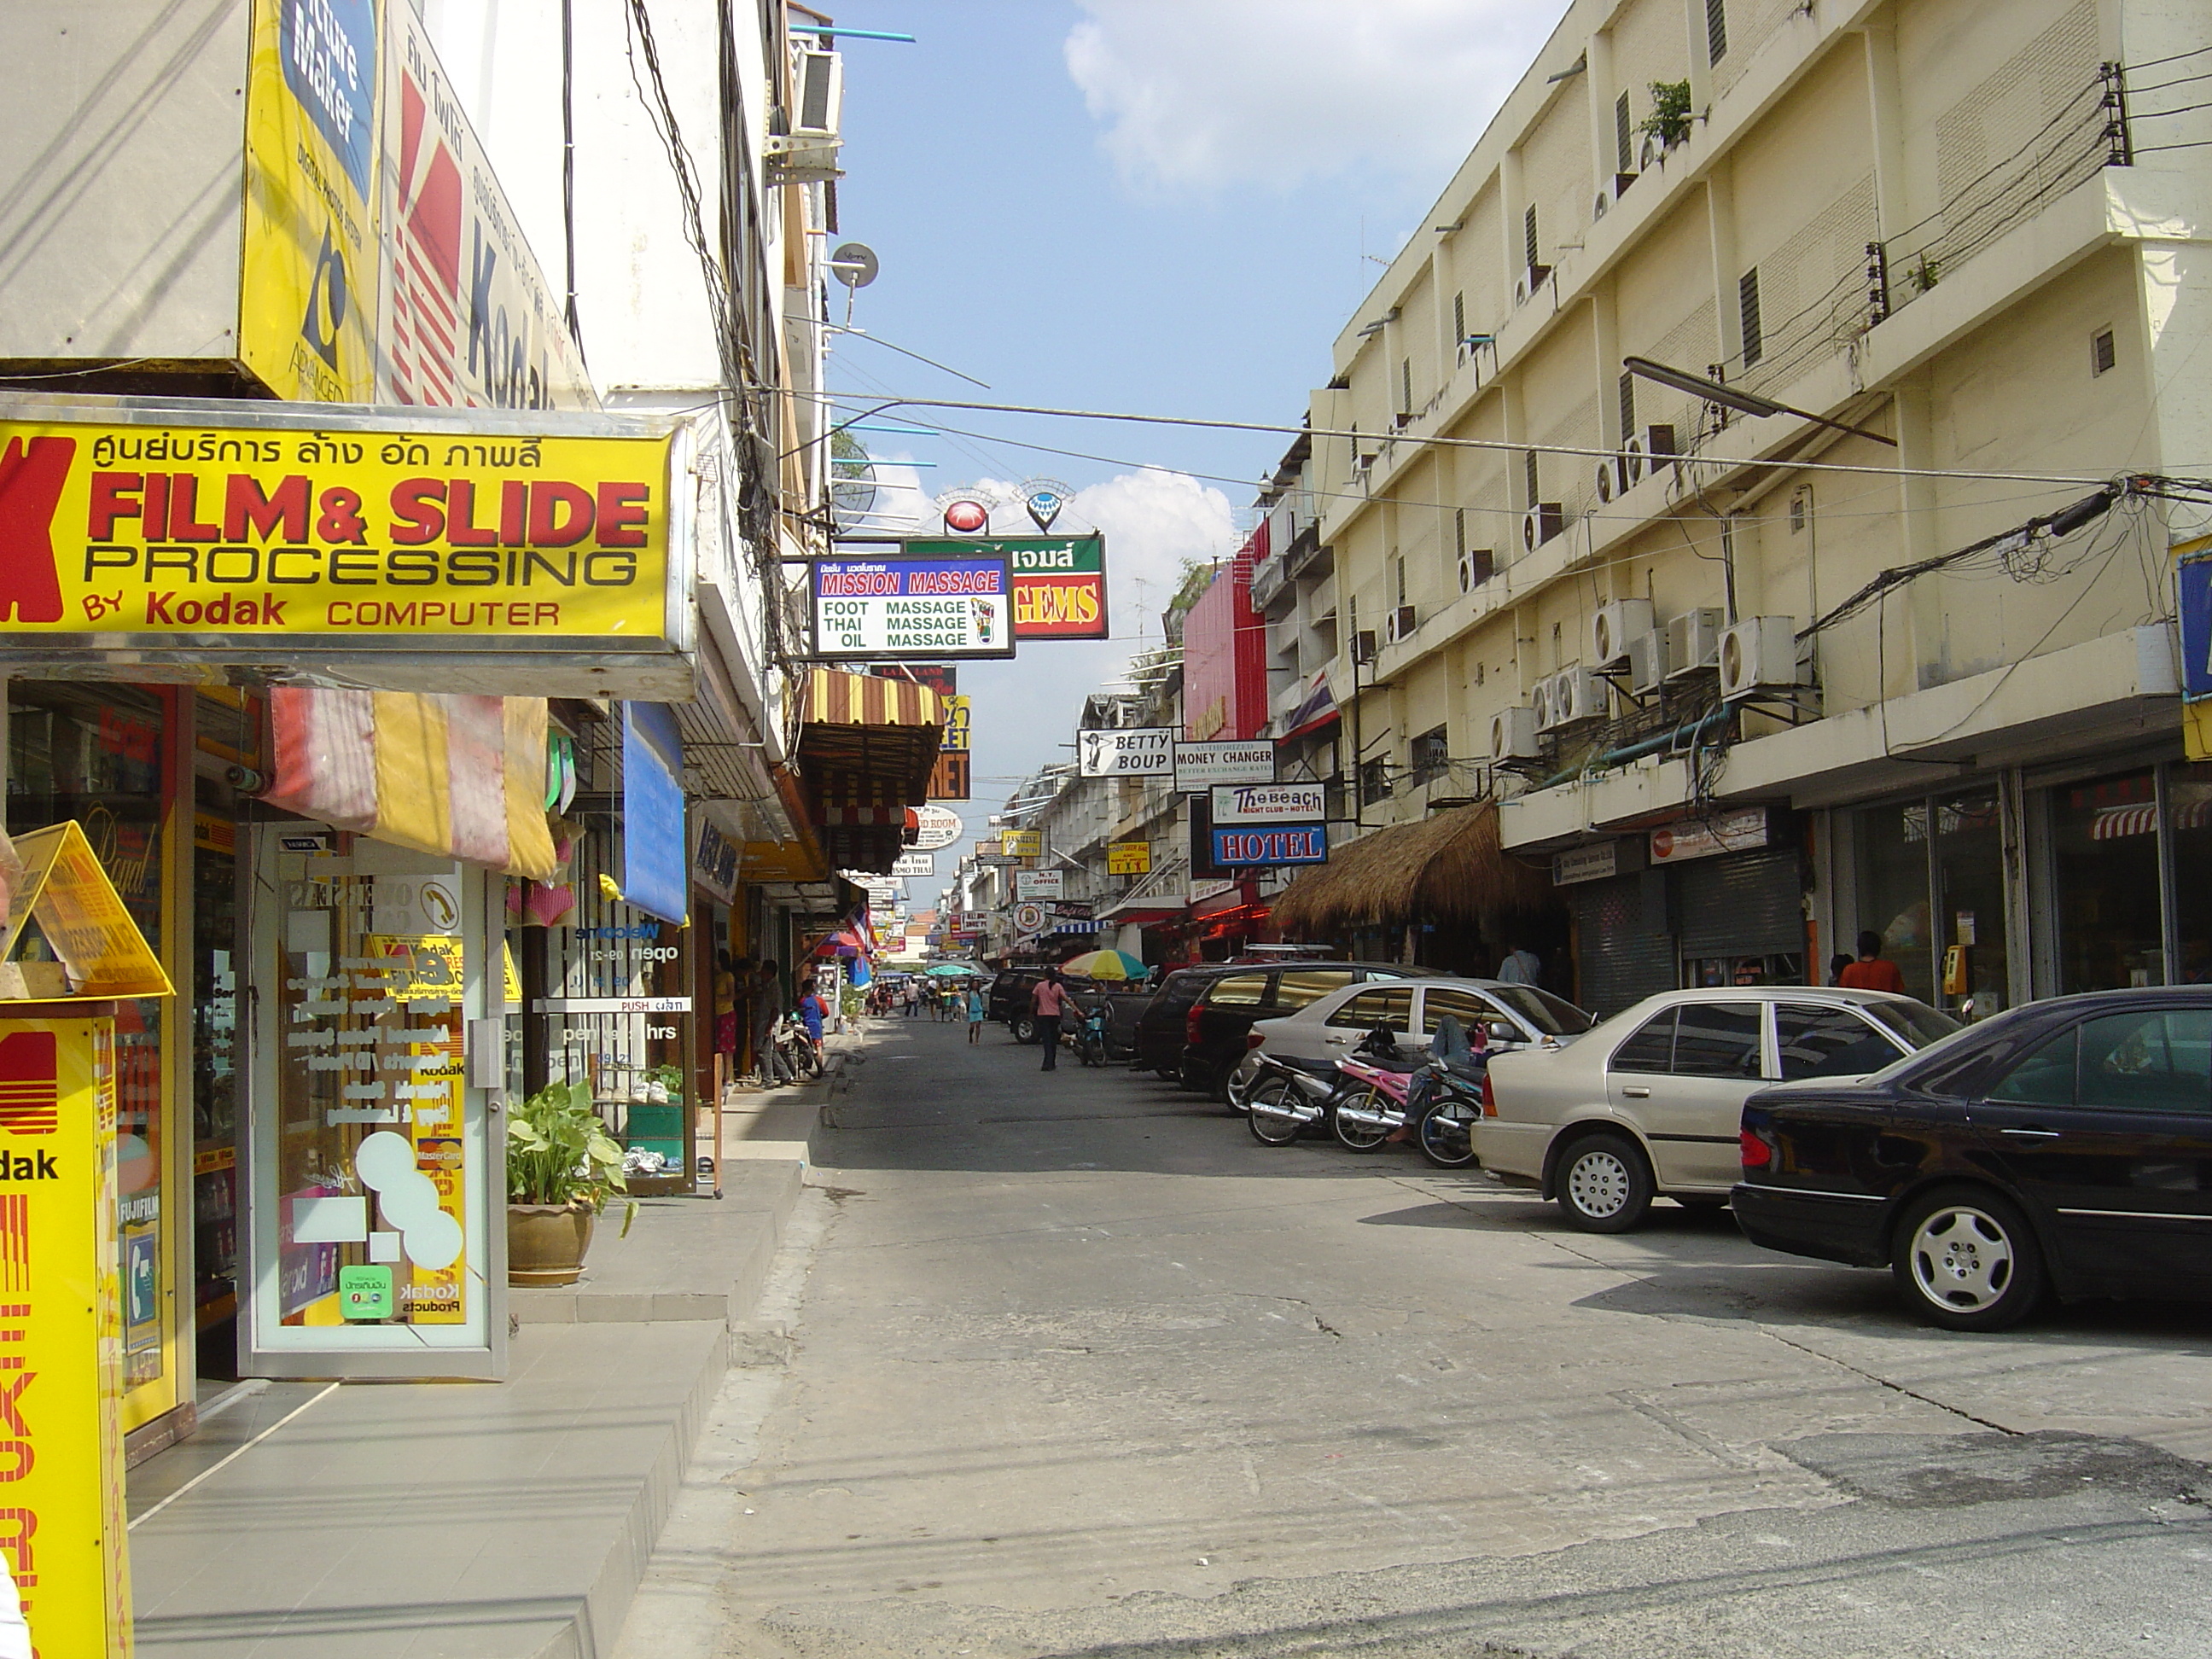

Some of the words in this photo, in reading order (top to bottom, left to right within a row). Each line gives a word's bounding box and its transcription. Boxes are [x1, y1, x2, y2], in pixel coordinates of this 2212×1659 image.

[293, 2, 353, 144] Maker
[297, 432, 364, 465] ล้าง
[381, 436, 429, 466] อัด
[444, 436, 542, 469] ภาพสี
[389, 477, 650, 548] SLIDE
[83, 544, 637, 587] PROCESSING
[820, 572, 900, 596] MISSION
[908, 569, 1000, 595] MASSAGE
[81, 589, 124, 622] BY
[145, 590, 288, 626] Kodak
[326, 600, 561, 627] COMPUTER
[824, 601, 870, 616] FOOT
[886, 600, 966, 614] MASSAGE
[1014, 582, 1099, 625] GEMS
[824, 617, 862, 632] THAI
[887, 616, 967, 631] MASSAGE
[841, 633, 867, 648] OIL
[887, 632, 968, 647] MASSAGE
[1115, 734, 1169, 751] BETTY
[1117, 754, 1167, 770] BOUP
[1177, 752, 1216, 765] MONEY
[1222, 750, 1272, 764] CHANGER
[1220, 831, 1323, 862] HOTEL
[621, 1001, 649, 1011] PUSH
[646, 1022, 677, 1040] hrs
[119, 1195, 160, 1222] FUJIFILM
